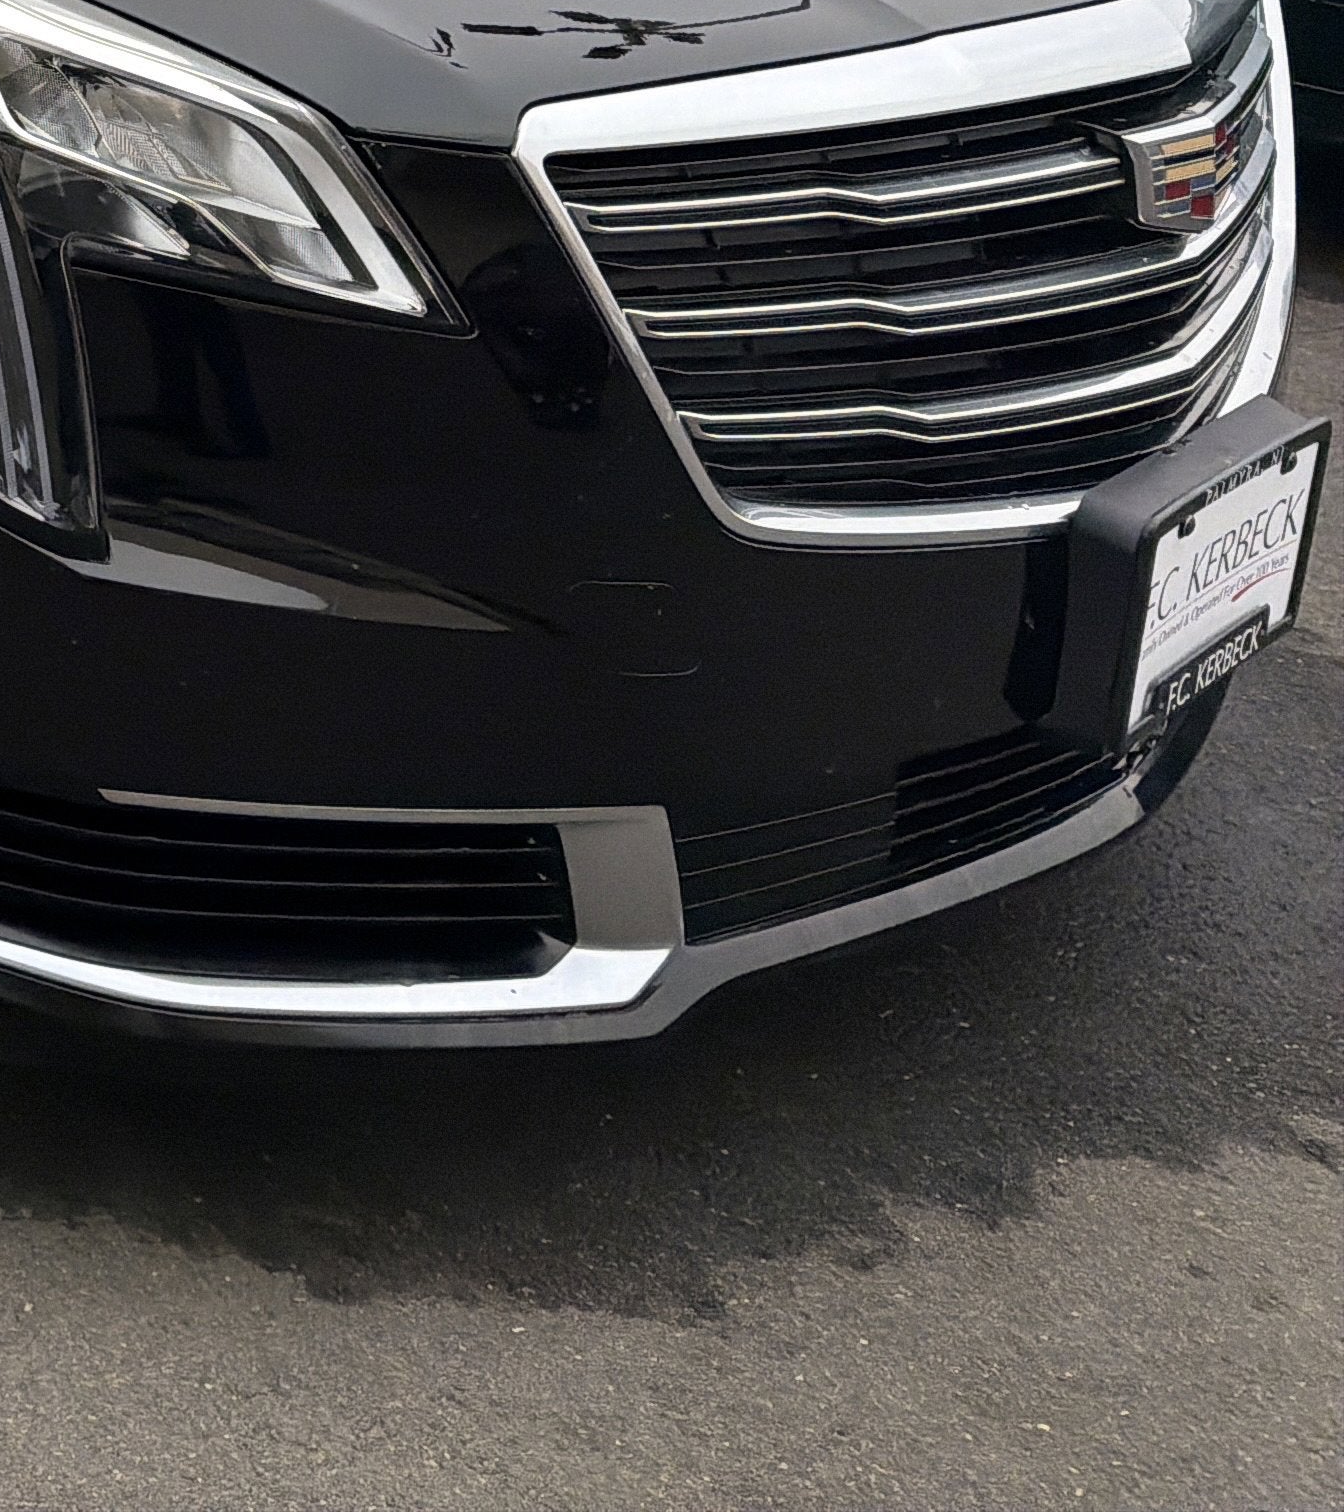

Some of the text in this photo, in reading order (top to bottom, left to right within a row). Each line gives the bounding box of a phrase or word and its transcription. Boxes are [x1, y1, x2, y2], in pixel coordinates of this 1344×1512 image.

[1186, 488, 1306, 601] KERBECK
[1236, 572, 1254, 592] Over
[1166, 622, 1263, 715] F.C. KERBECK
